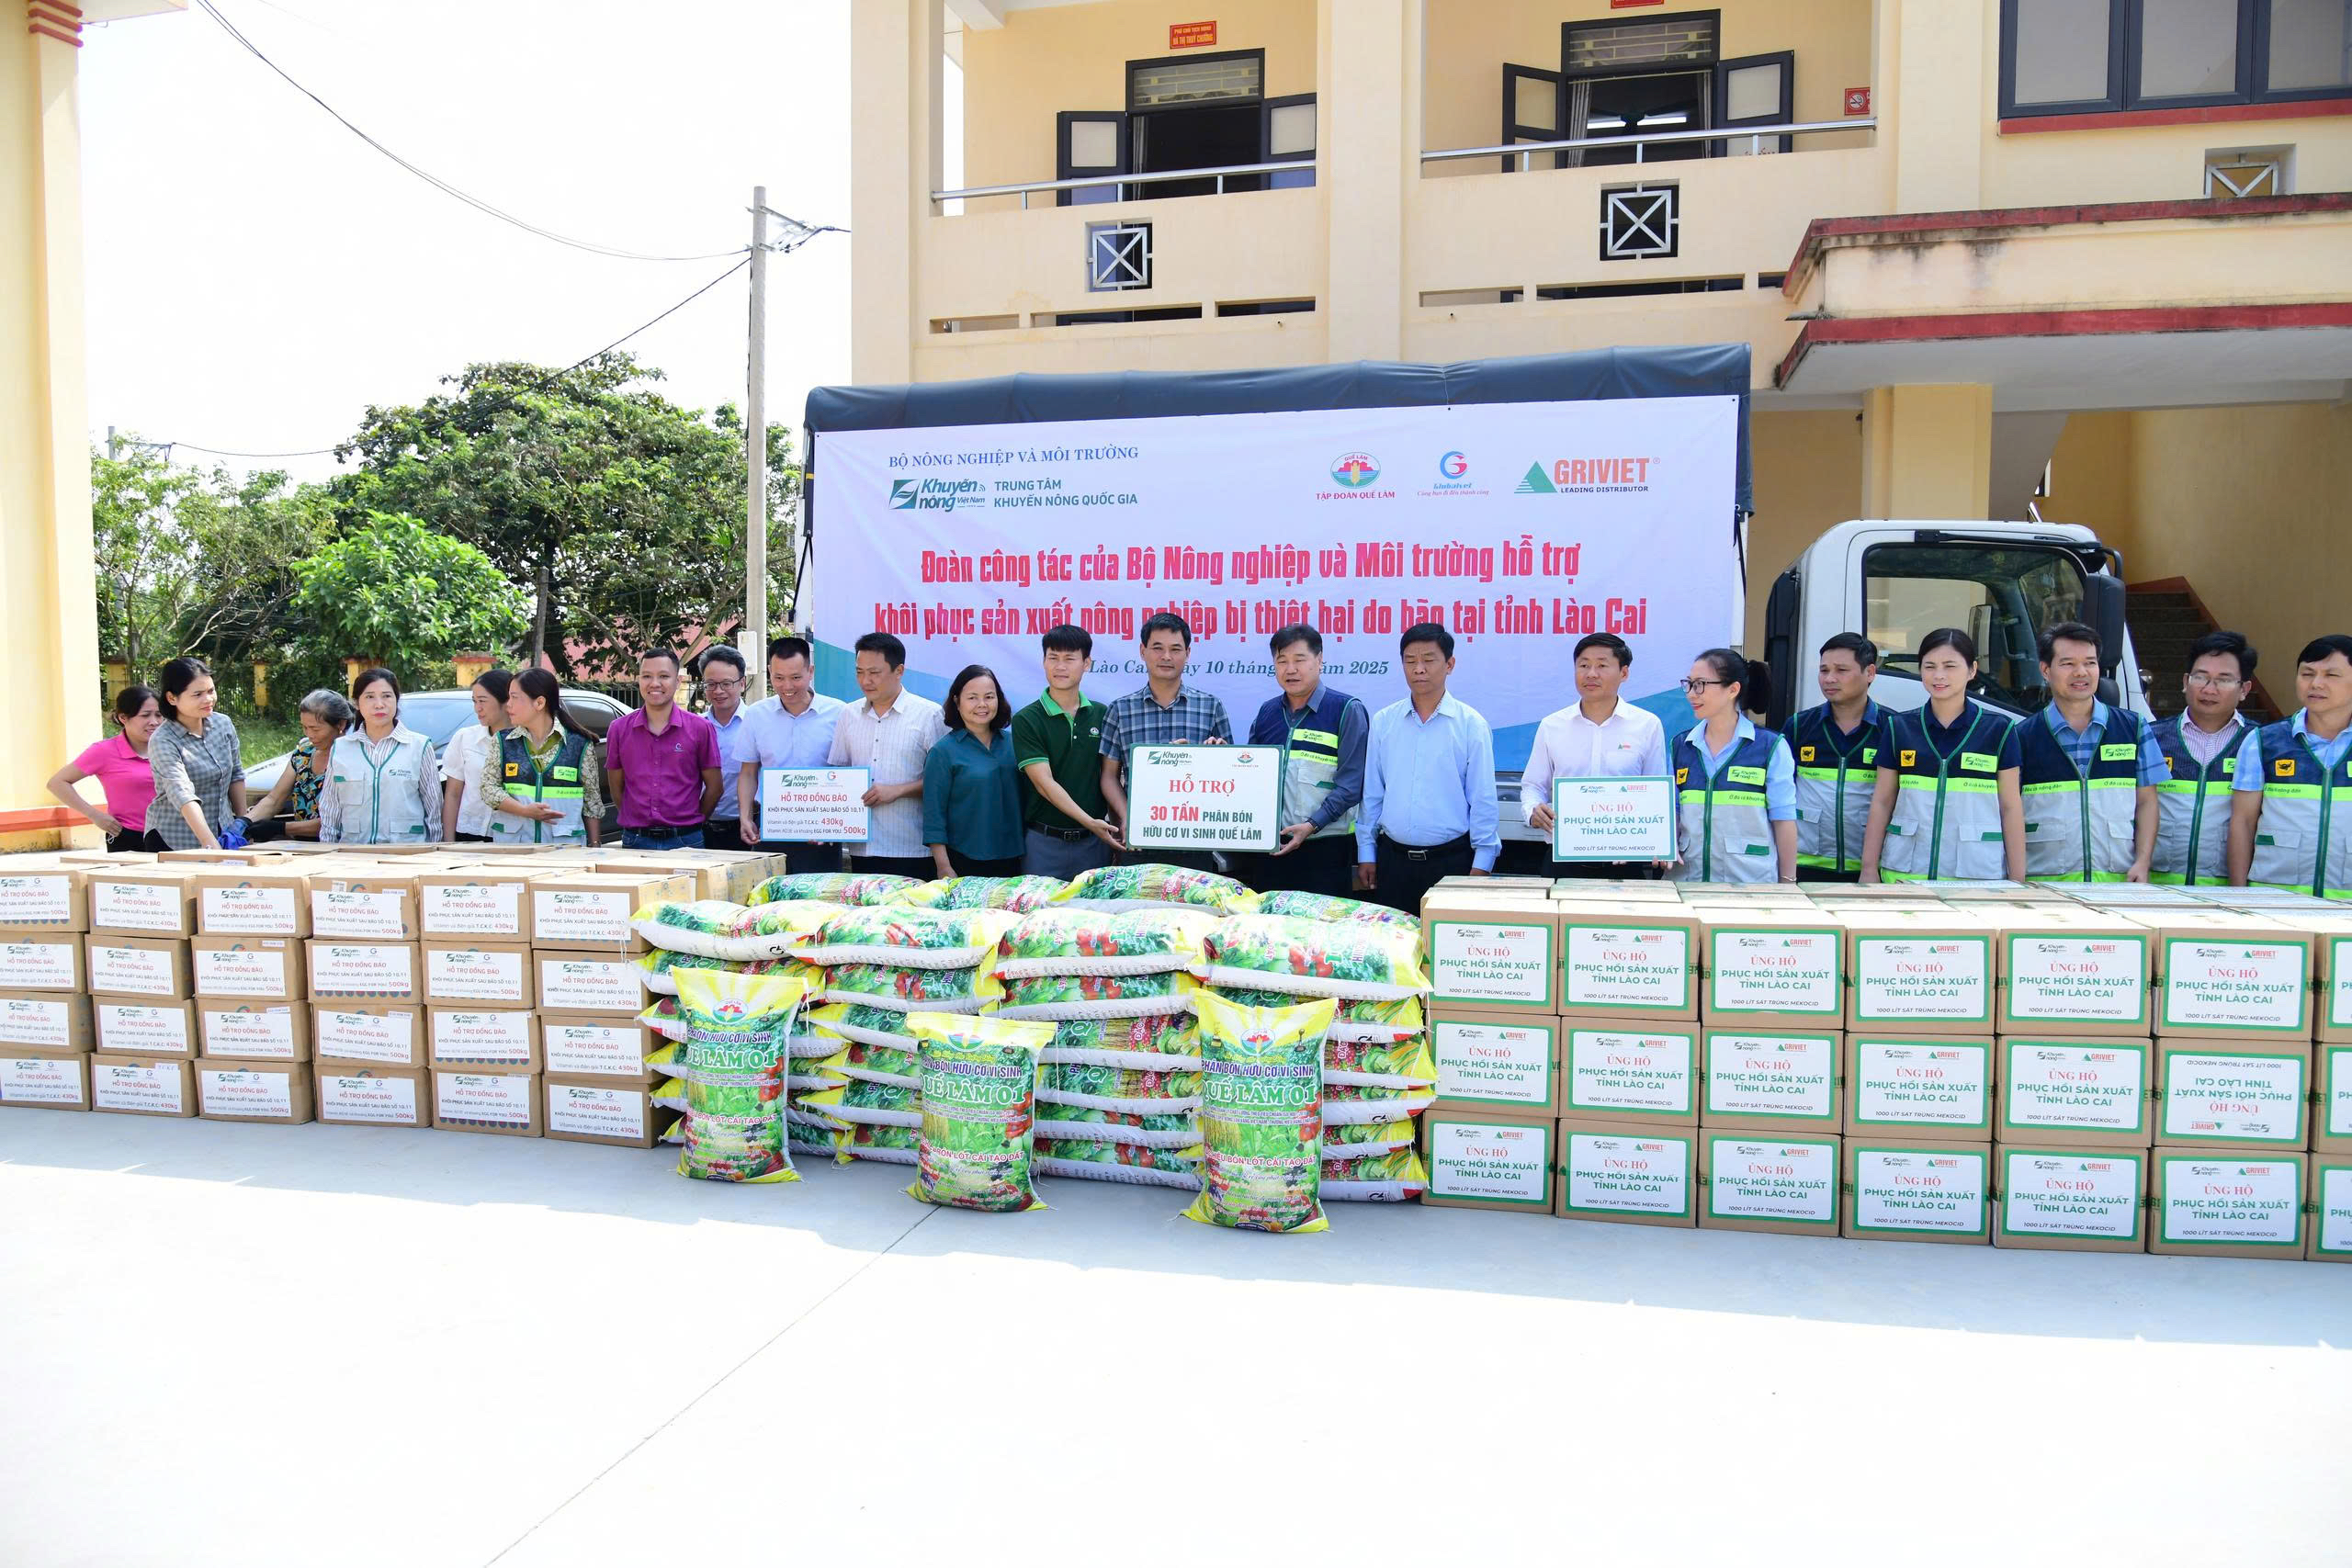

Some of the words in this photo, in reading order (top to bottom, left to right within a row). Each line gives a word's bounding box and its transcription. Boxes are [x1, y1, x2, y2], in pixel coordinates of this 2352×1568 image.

[888, 453, 908, 470] BỘ
[911, 451, 953, 467] NÔNG
[956, 448, 1013, 466] NGHIỆP
[1018, 446, 1038, 462] VÀ
[1041, 446, 1070, 461] MÔI
[1074, 443, 1139, 461] TRƯỜNG
[1554, 457, 1650, 484] GRIVIET
[921, 478, 978, 496] Khuyến
[994, 479, 1035, 491] TRUNG
[1037, 477, 1062, 491] TÂM
[1560, 486, 1593, 494] LEADING
[1596, 485, 1648, 493] DISTRIBUTOR
[994, 492, 1043, 507] KHUYẾN
[1046, 492, 1080, 506] NÔNG
[1082, 491, 1114, 506] QUỐC
[1117, 493, 1138, 505] GIA
[1316, 491, 1331, 502] TẬP
[1333, 491, 1359, 500] ĐOÀN
[1360, 489, 1375, 500] QUẾ
[1377, 490, 1396, 500] LÂM
[919, 493, 956, 513] nông
[921, 549, 972, 584] Đoàn
[979, 548, 1031, 588] công
[1037, 547, 1072, 581] tác
[1080, 544, 1120, 582] của
[1126, 546, 1156, 589] Bộ
[1163, 545, 1224, 586] Nông
[1231, 543, 1311, 587] nghiệp
[1318, 543, 1347, 578] và
[1355, 541, 1403, 578] Môi
[1412, 540, 1494, 583] trường
[1502, 535, 1533, 577] hỗ
[1542, 540, 1581, 585] trợ
[875, 602, 918, 636] khôi
[924, 602, 974, 643] phục
[981, 598, 1021, 636] sản
[1026, 596, 1074, 635] xuất
[1080, 600, 1134, 641] nông
[1226, 599, 1247, 643] bị
[1318, 599, 1355, 644] hại
[1363, 599, 1392, 634] do
[1400, 598, 1444, 634] bão
[1453, 597, 1486, 643] tại
[1494, 594, 1544, 635] tỉnh
[1552, 597, 1596, 635] Lào
[1605, 597, 1647, 635] Cai
[1090, 660, 1119, 674] Lào
[1205, 660, 1224, 674] 10
[1228, 660, 1276, 677] tháng
[1320, 662, 1344, 675] ăm
[1348, 660, 1389, 675] 2025
[1169, 773, 1194, 794] HỖ
[1198, 779, 1236, 797] TRỢ
[781, 792, 792, 802] HỖ
[794, 794, 808, 803] TRỢ
[809, 793, 831, 802] ĐỒNG
[831, 793, 848, 802] BÀO
[1150, 806, 1168, 821] 30
[1171, 801, 1199, 822] TẤN
[1203, 809, 1230, 823] PHÂN
[1232, 810, 1253, 823] BÓN
[1617, 802, 1633, 814] HỘ
[821, 818, 843, 826] 430kg
[1564, 817, 1591, 826] PHỤC
[1594, 815, 1611, 825] HỒI
[1615, 814, 1634, 824] SẢN
[1638, 814, 1665, 824] XUẤT
[843, 827, 866, 836] 500kg
[1143, 826, 1162, 839] HỮU
[1165, 827, 1178, 839] CƠ
[1181, 828, 1190, 839] VI
[1193, 828, 1216, 840] SINH
[1218, 826, 1238, 840] QUẾ
[1240, 827, 1261, 840] LÂM
[1580, 825, 1604, 835] TỈNH
[1607, 826, 1627, 835] LÀO
[1494, 946, 1510, 959] HỘ
[1440, 959, 1468, 968] PHỤC
[1470, 959, 1488, 968] HỒI
[1491, 959, 1511, 969] SẢN
[1514, 961, 1542, 970] XUẤT
[1457, 968, 1480, 978] TỈNH
[1483, 970, 1503, 979] LÀO
[702, 1045, 744, 1069] LÂM
[1224, 1062, 1240, 1075] BÓN
[1242, 1064, 1262, 1077] HỮU
[1264, 1066, 1278, 1077] CƠ
[1281, 1066, 1290, 1077] VI
[1293, 1064, 1314, 1077] SINH
[2196, 1077, 2214, 1086] CAI
[946, 1078, 992, 1104] LÂM
[1236, 1080, 1286, 1105] LÂM
[592, 1103, 608, 1111] ĐỒNG
[1227, 1155, 1244, 1165] BÓN
[1246, 1156, 1264, 1167] LÓT
[1266, 1157, 1282, 1167] CẢI
[1283, 1157, 1301, 1168] TẠO
[1303, 1156, 1316, 1165] ĐẤT
